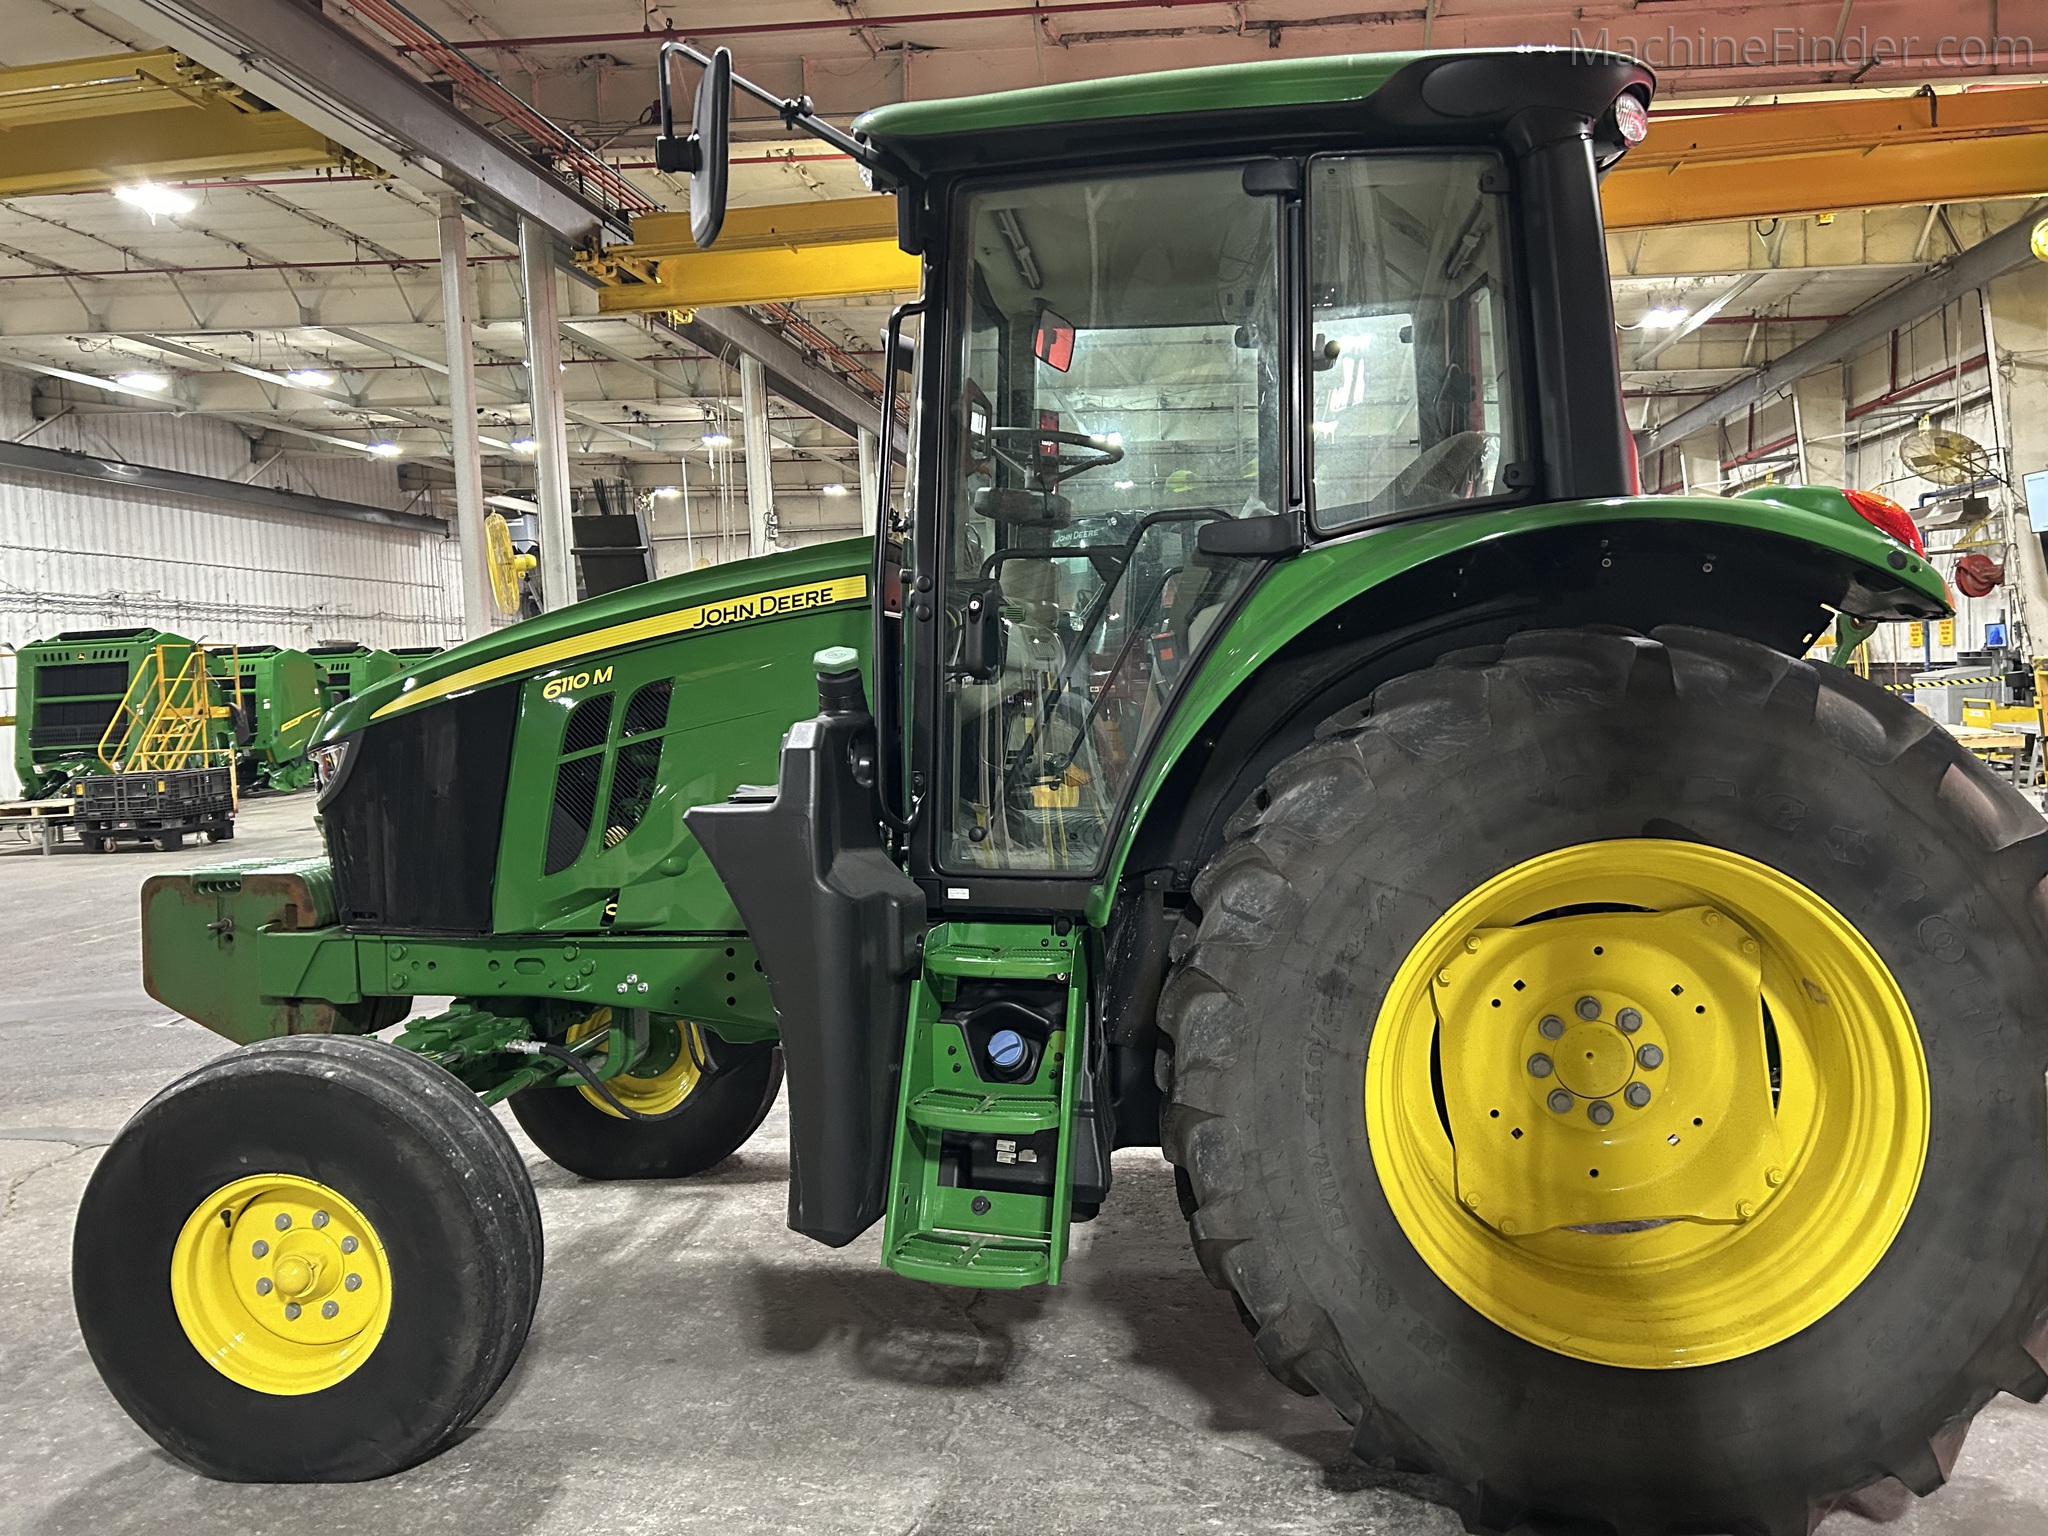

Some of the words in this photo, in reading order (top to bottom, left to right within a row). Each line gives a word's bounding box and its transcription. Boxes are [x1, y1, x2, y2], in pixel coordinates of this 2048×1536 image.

[693, 602, 754, 628] JOHN
[759, 587, 834, 615] DEERE
[542, 672, 590, 700] 6110
[593, 665, 614, 685] M
